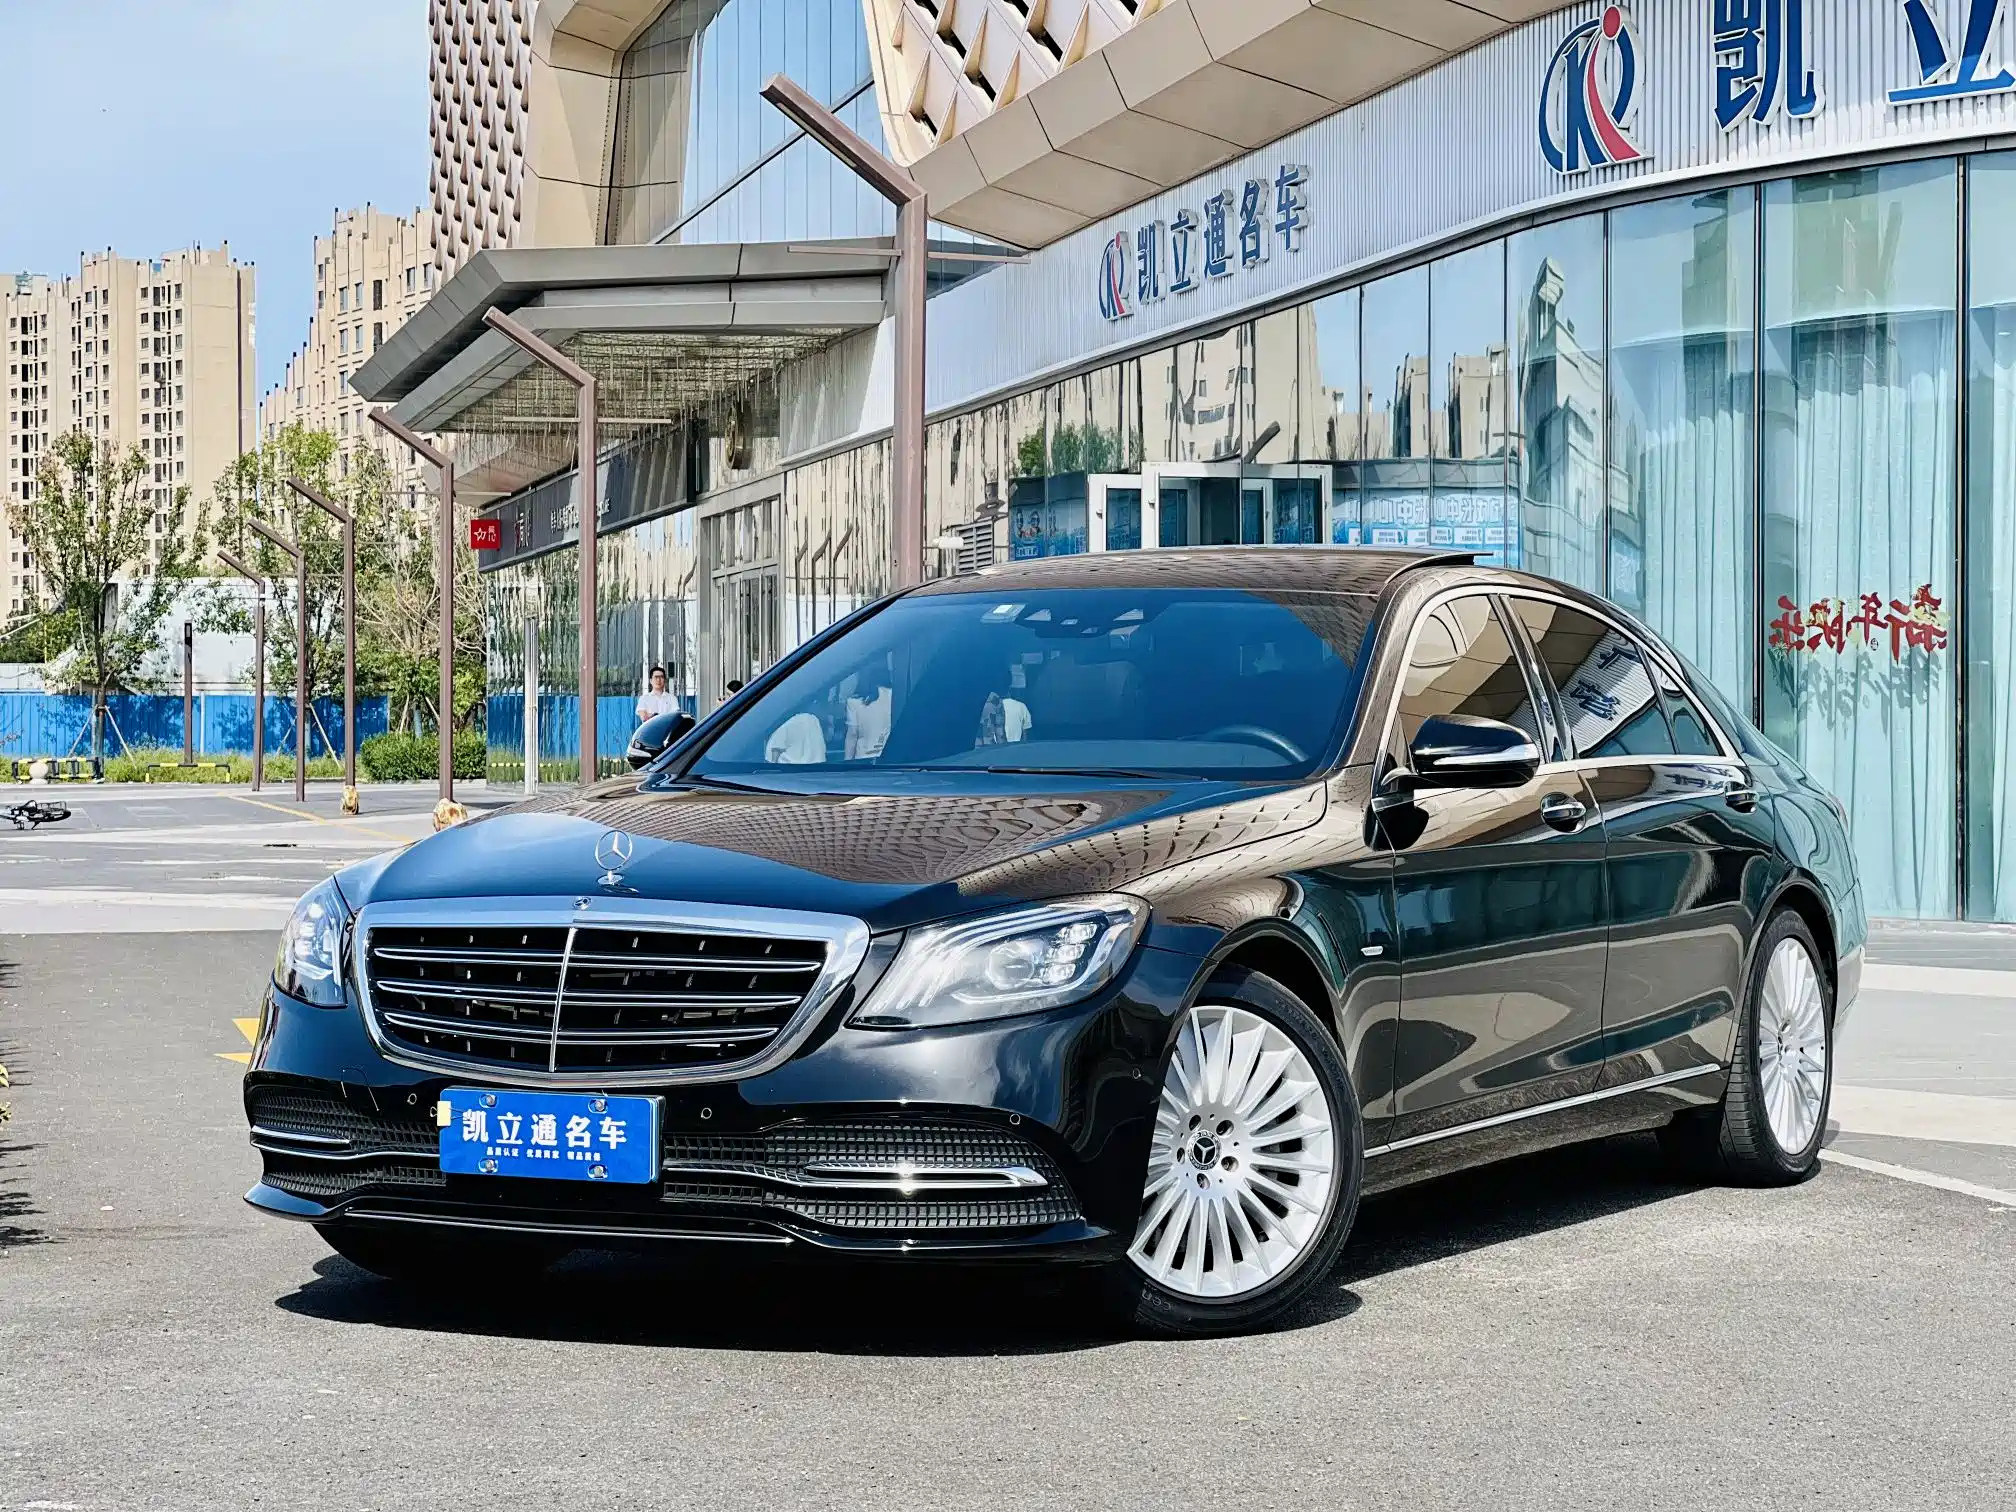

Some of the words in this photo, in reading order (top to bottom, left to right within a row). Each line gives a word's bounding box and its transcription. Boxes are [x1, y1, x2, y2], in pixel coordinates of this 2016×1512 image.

[1138, 164, 1308, 305] 凯立通名车
[462, 1109, 627, 1150] 凯立通名车
